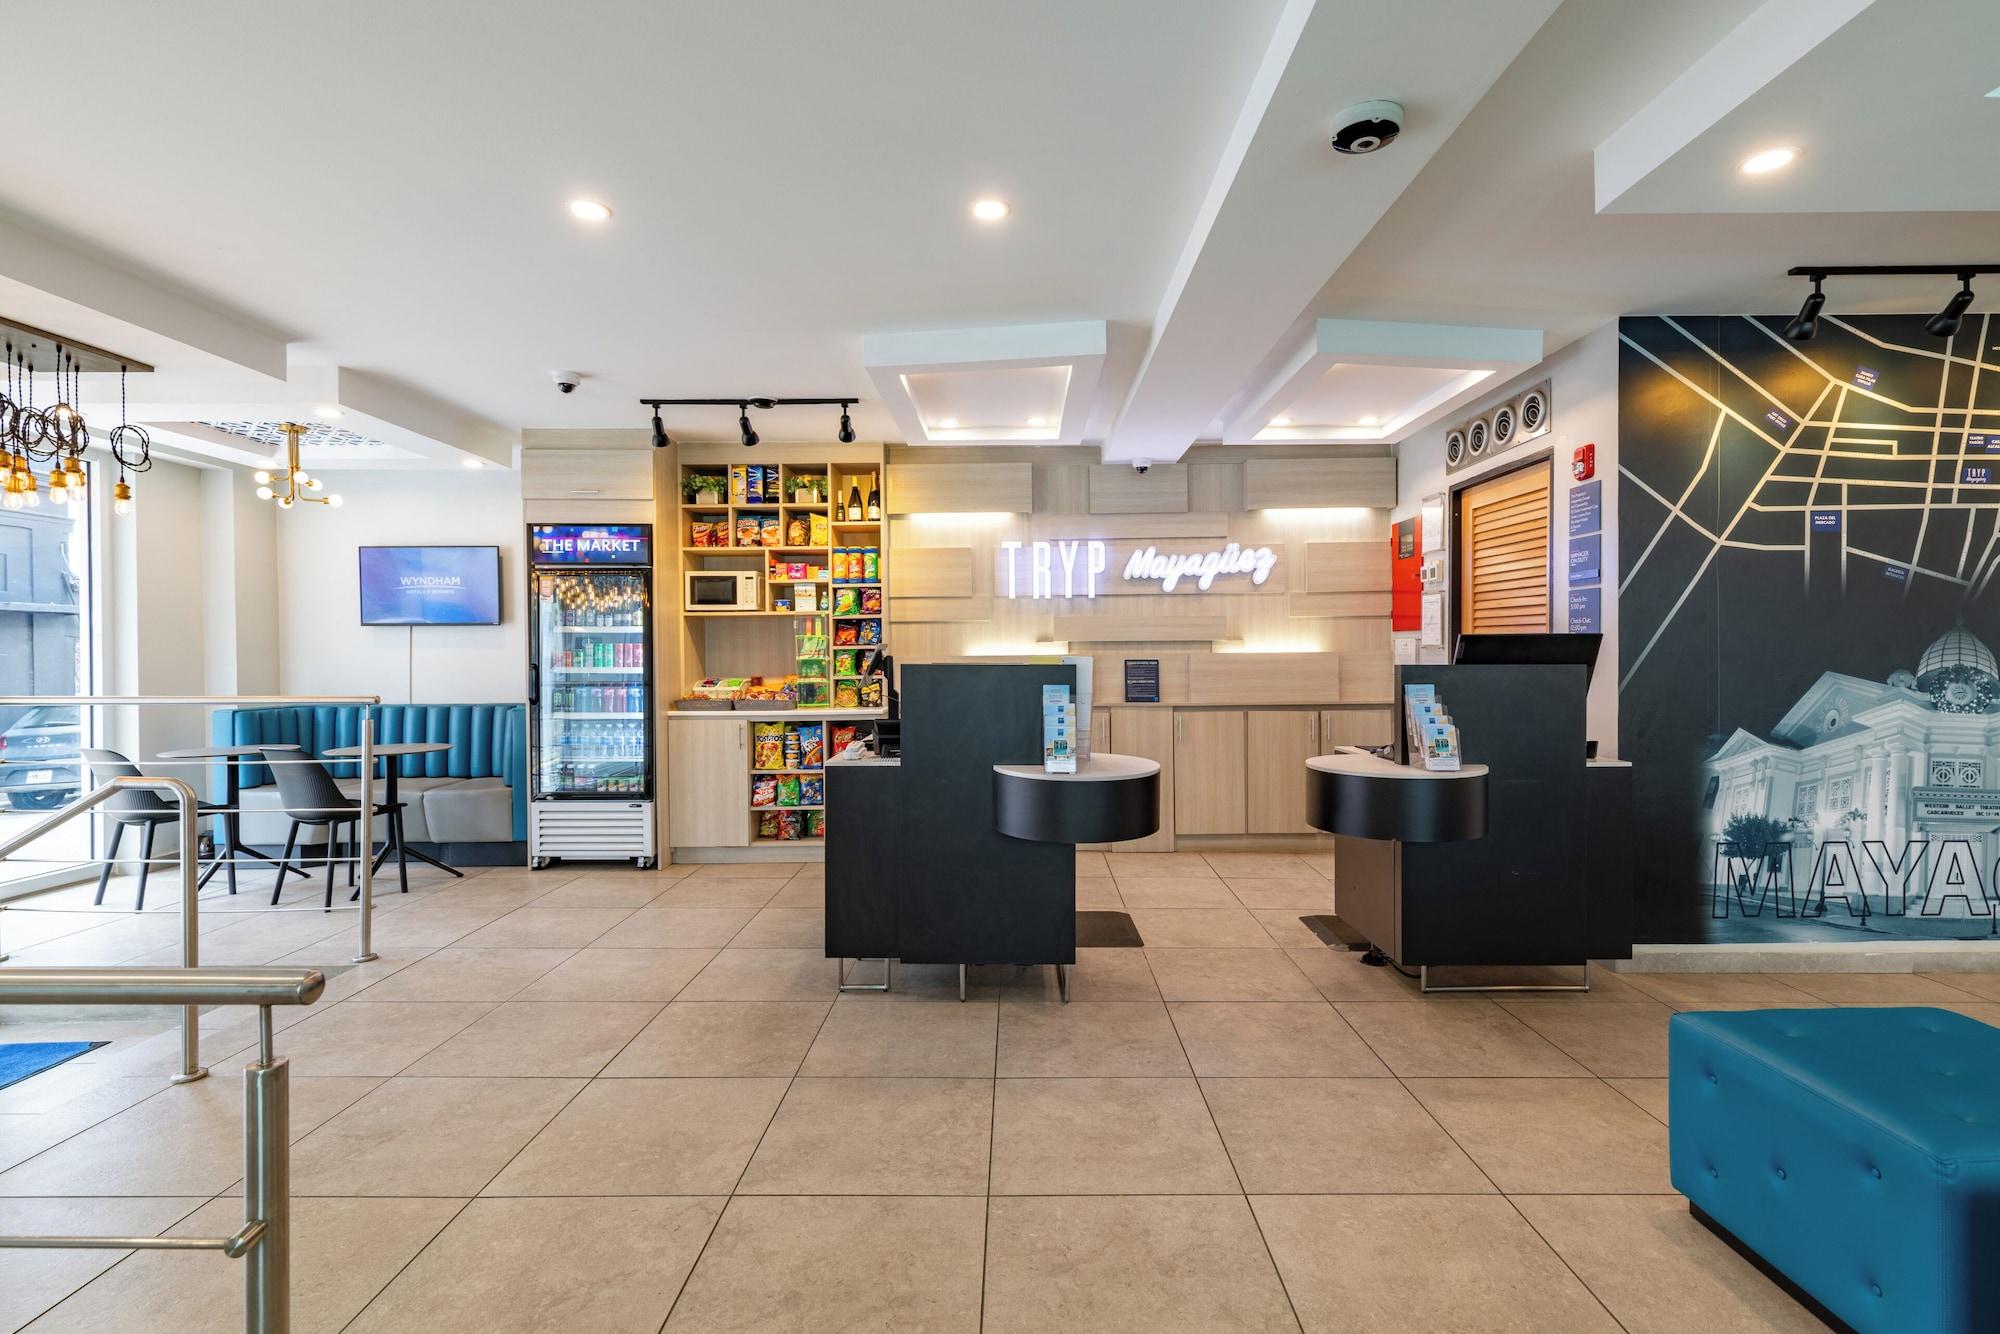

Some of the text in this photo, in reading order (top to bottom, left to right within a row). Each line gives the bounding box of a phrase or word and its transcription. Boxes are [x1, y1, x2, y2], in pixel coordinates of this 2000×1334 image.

[1967, 468, 1985, 477] TRYP
[542, 539, 640, 551] THE MARKET
[1001, 540, 1277, 600] TRYP Mayagüez
[400, 576, 461, 585] WYNDHAM
[756, 735, 783, 743] TOSTITOS
[1712, 840, 2000, 918] MAYA
